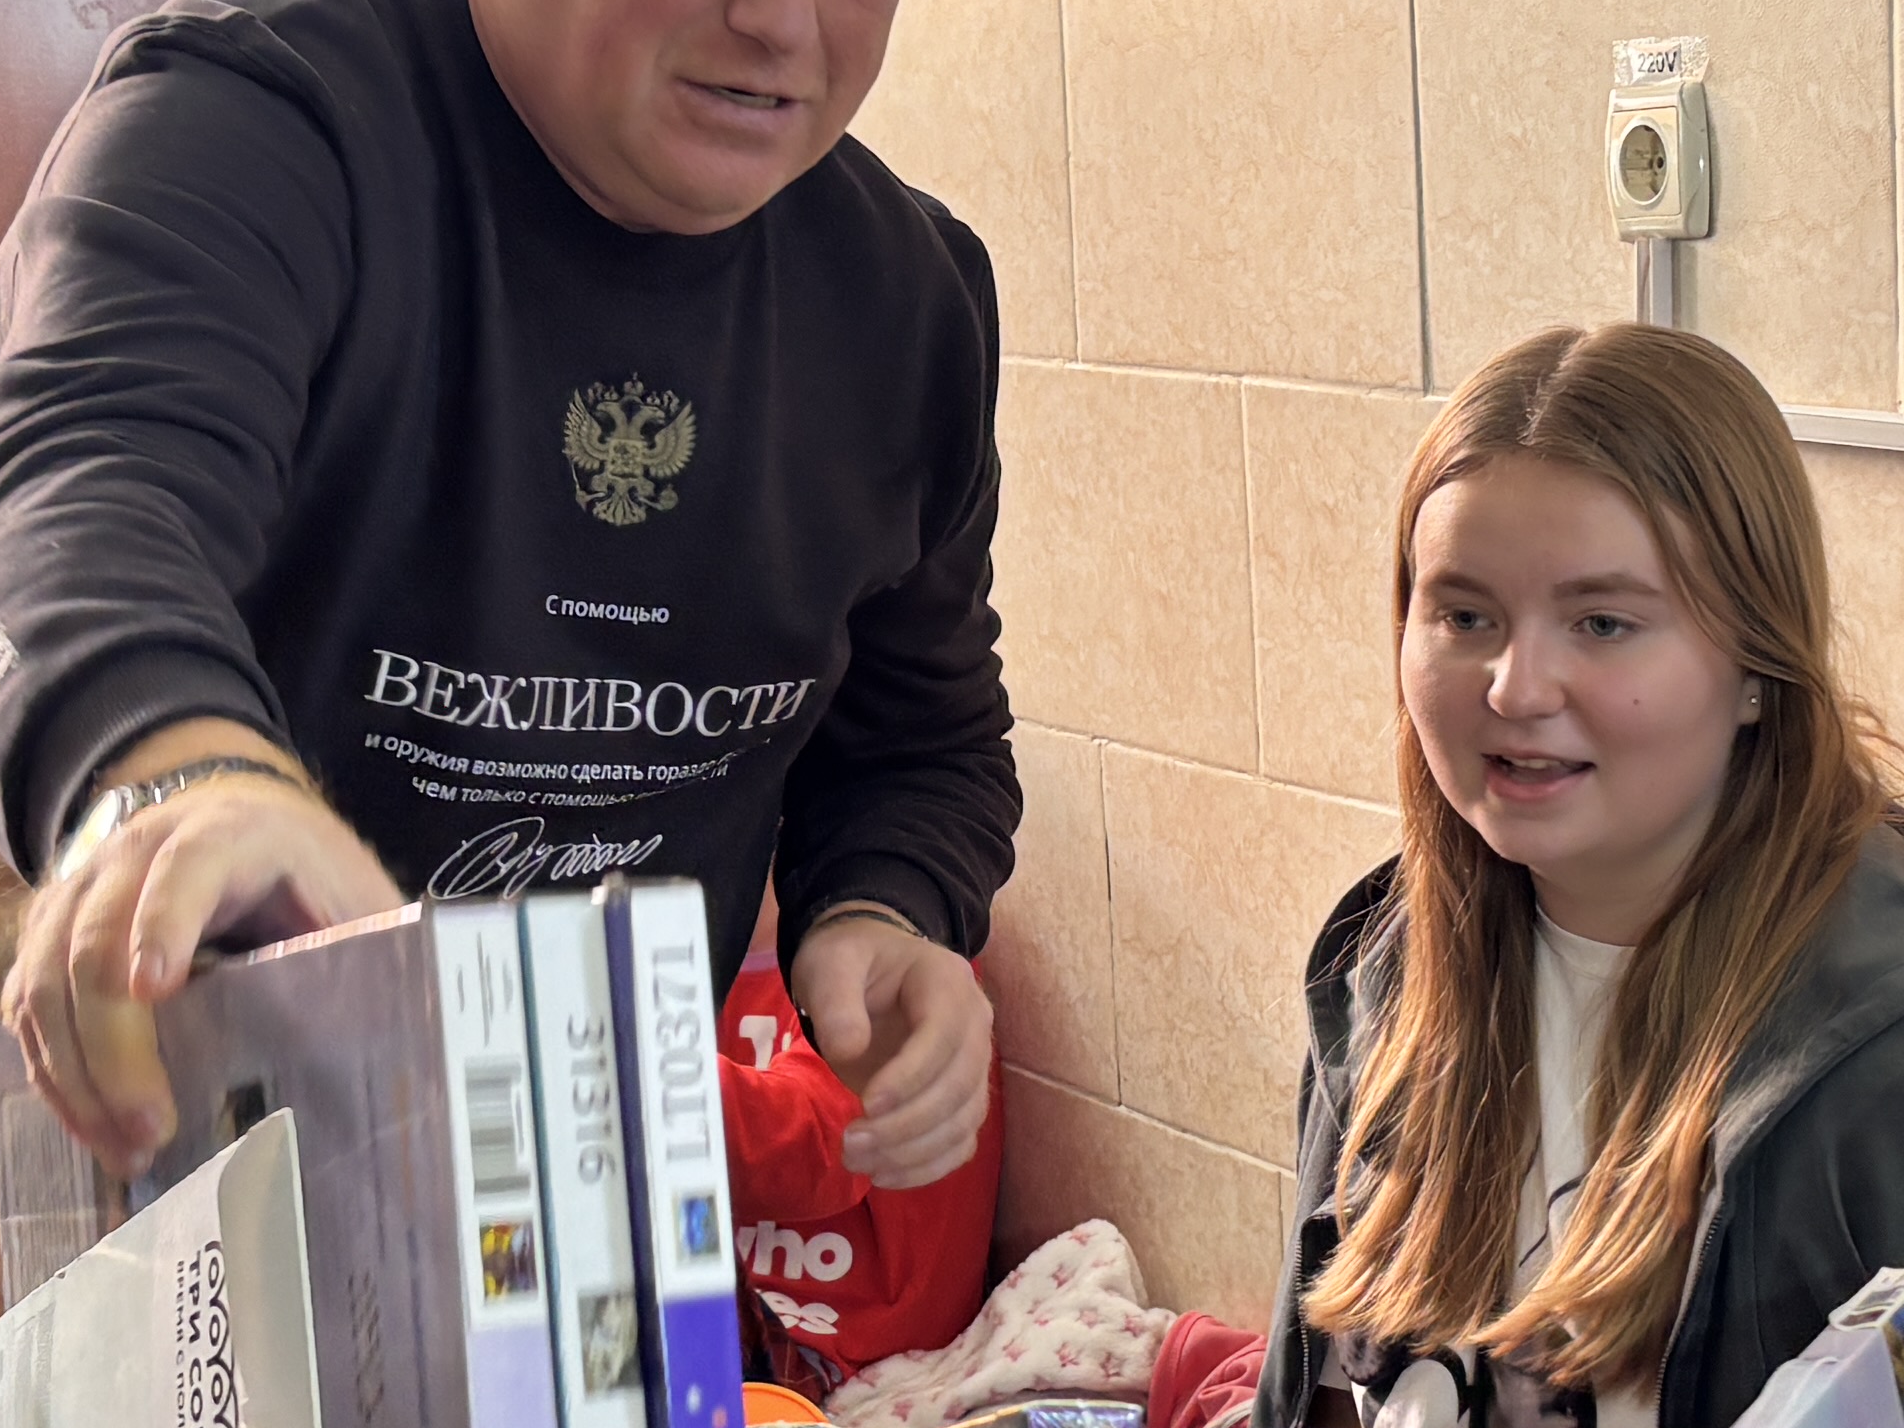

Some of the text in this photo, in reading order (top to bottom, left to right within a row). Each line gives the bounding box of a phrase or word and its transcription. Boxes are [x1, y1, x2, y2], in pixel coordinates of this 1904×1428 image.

[545, 594, 670, 625] С помощью
[364, 649, 816, 737] ВЕЖЛИВОСТИ
[365, 733, 381, 749] и
[383, 736, 470, 774] оружия
[471, 759, 569, 780] возможно
[570, 762, 644, 785] сделать
[411, 775, 458, 802] чем
[460, 786, 526, 803] только
[528, 791, 541, 805] с
[567, 1012, 616, 1185] 31316
[188, 1250, 203, 1344] ТРИ
